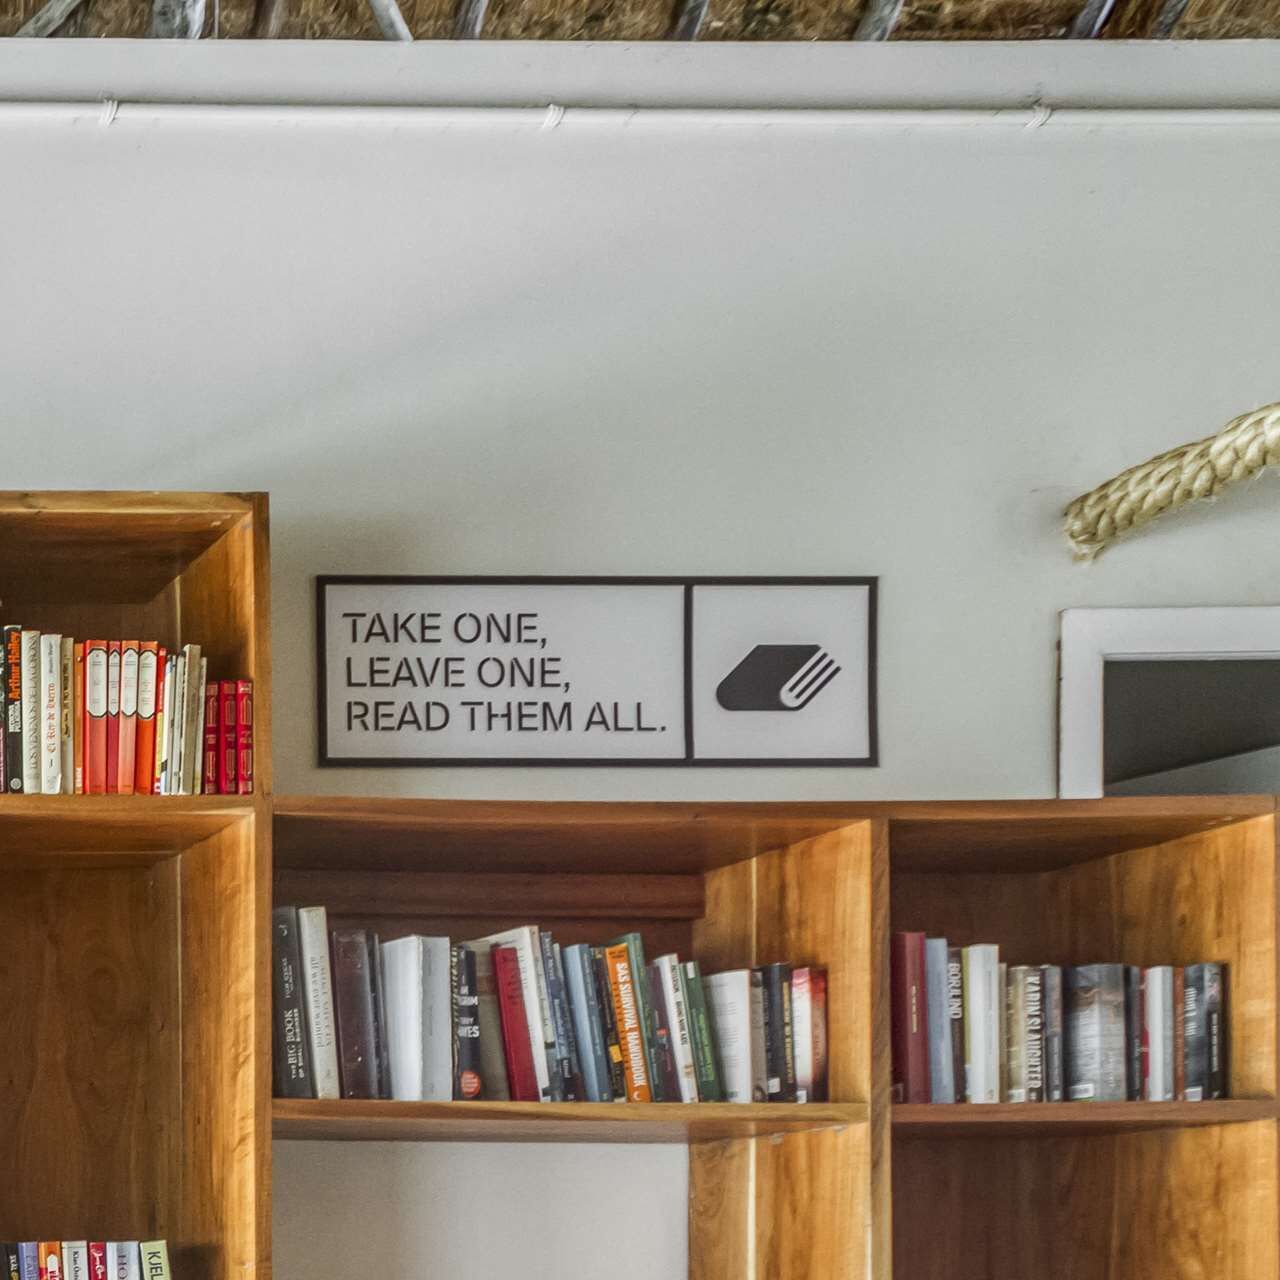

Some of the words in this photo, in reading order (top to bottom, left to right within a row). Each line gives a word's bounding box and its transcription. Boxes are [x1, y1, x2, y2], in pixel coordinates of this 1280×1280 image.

[342, 612, 442, 643] TAKE
[453, 612, 548, 649] ONE,
[346, 657, 466, 688] LEAVE
[477, 657, 571, 693] ONE,
[347, 701, 450, 731] READ
[460, 701, 573, 731] THEM
[584, 701, 666, 732] ALL.
[615, 961, 630, 982] SAS
[617, 983, 638, 1029] SURVIVAL
[1025, 976, 1040, 1014] KARIN
[283, 1009, 294, 1041] BOOK
[286, 1045, 296, 1063] BIG
[625, 1031, 647, 1086] HANDBOOK
[1026, 1017, 1040, 1088] SLAUGHTER
